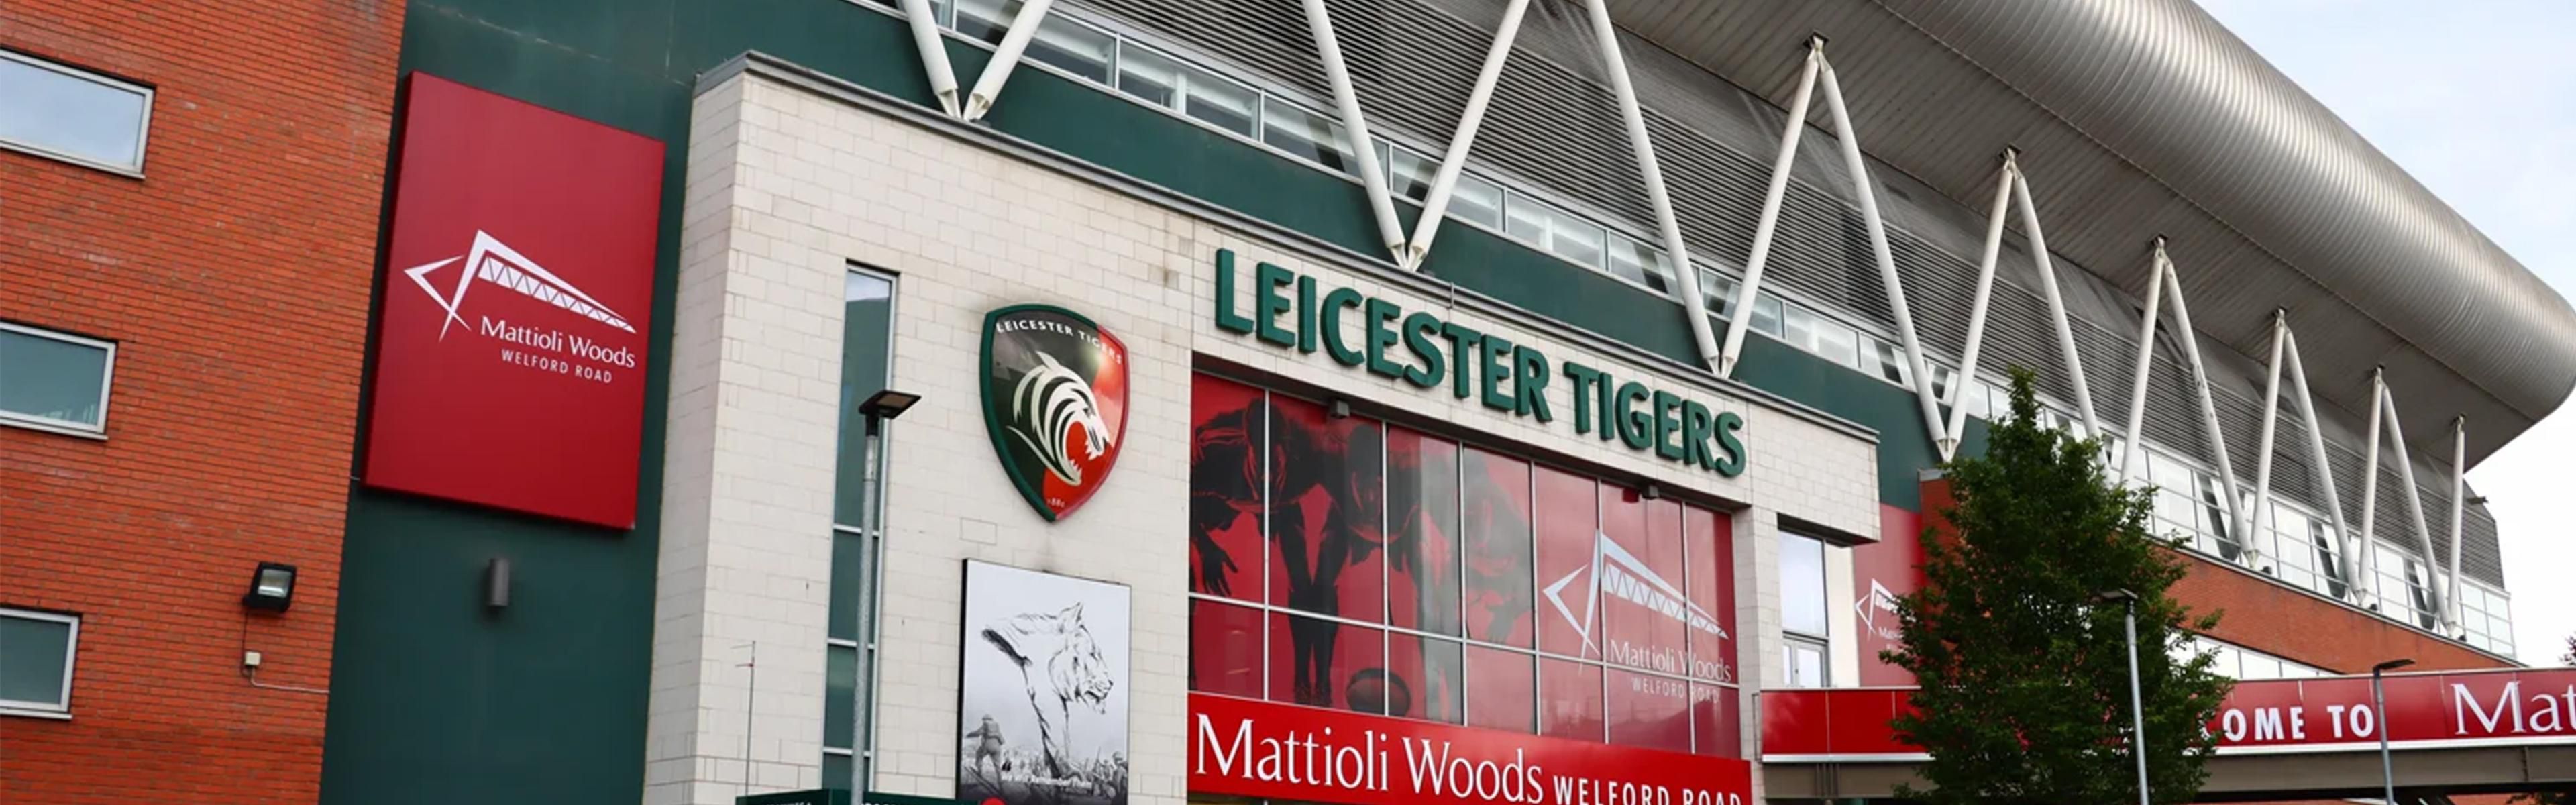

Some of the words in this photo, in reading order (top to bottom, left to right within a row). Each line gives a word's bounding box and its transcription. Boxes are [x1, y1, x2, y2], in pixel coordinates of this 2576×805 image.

[481, 315, 563, 352] Mattioli
[569, 334, 635, 368] Woods
[996, 319, 1073, 337] LEICESTER
[1077, 330, 1122, 364] TIGERS
[1215, 248, 1553, 423] LEICESTER
[1563, 361, 1746, 477] TIGERS
[502, 348, 568, 374] WELFORD
[575, 364, 612, 383] ROAD
[1610, 639, 1674, 673] Mattioli
[1678, 650, 1731, 682] Woods
[1631, 676, 1686, 699] WELFORD
[2326, 704, 2375, 737] TO
[1195, 712, 1389, 792] Mattioli
[1402, 737, 1544, 804] Woods
[1553, 775, 1669, 805] WELFORD
